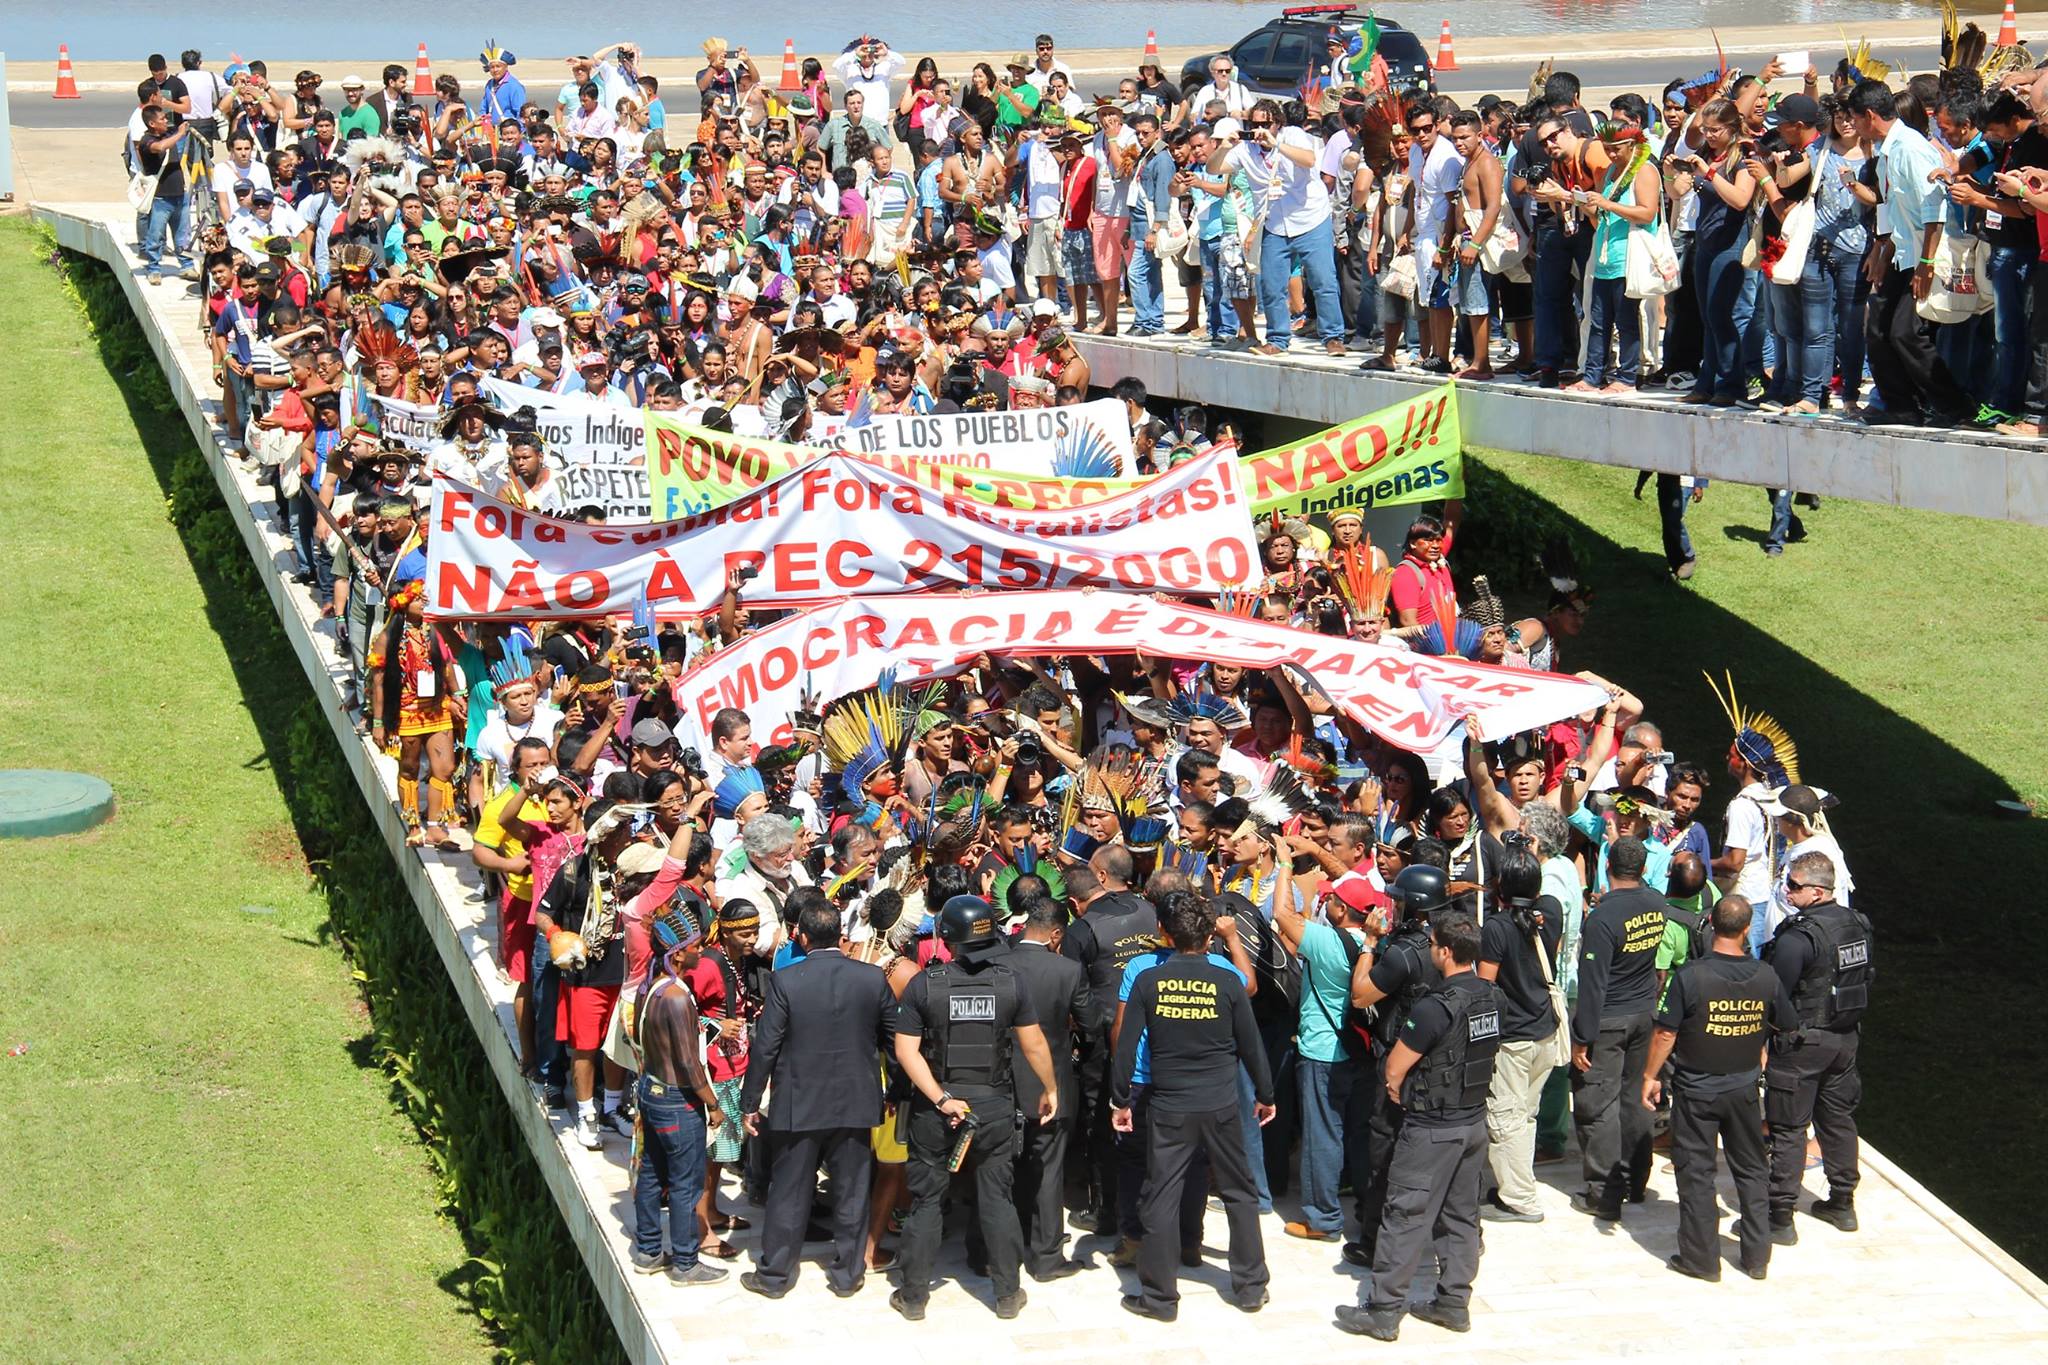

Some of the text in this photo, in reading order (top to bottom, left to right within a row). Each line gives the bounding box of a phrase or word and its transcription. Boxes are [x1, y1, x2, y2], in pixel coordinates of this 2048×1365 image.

[585, 414, 644, 451] Indíge
[852, 425, 887, 453] DE
[897, 417, 942, 449] LOS
[956, 410, 1070, 447] PUEBLOS
[656, 428, 769, 488] POVO
[441, 491, 566, 544] Fora
[802, 468, 924, 516] Fora
[1301, 459, 1450, 514] Indigenas
[438, 536, 1250, 613] NÃO À PEC 215/2000
[695, 611, 1073, 737] EMOCRACIA
[1094, 603, 1148, 634] É
[1155, 1004, 1219, 1019] FEDERAL
[1158, 994, 1216, 1006] LEGISLATIVA
[1709, 1013, 1763, 1022] LEGISLATIVA
[1705, 1022, 1763, 1036] FEDERAL
